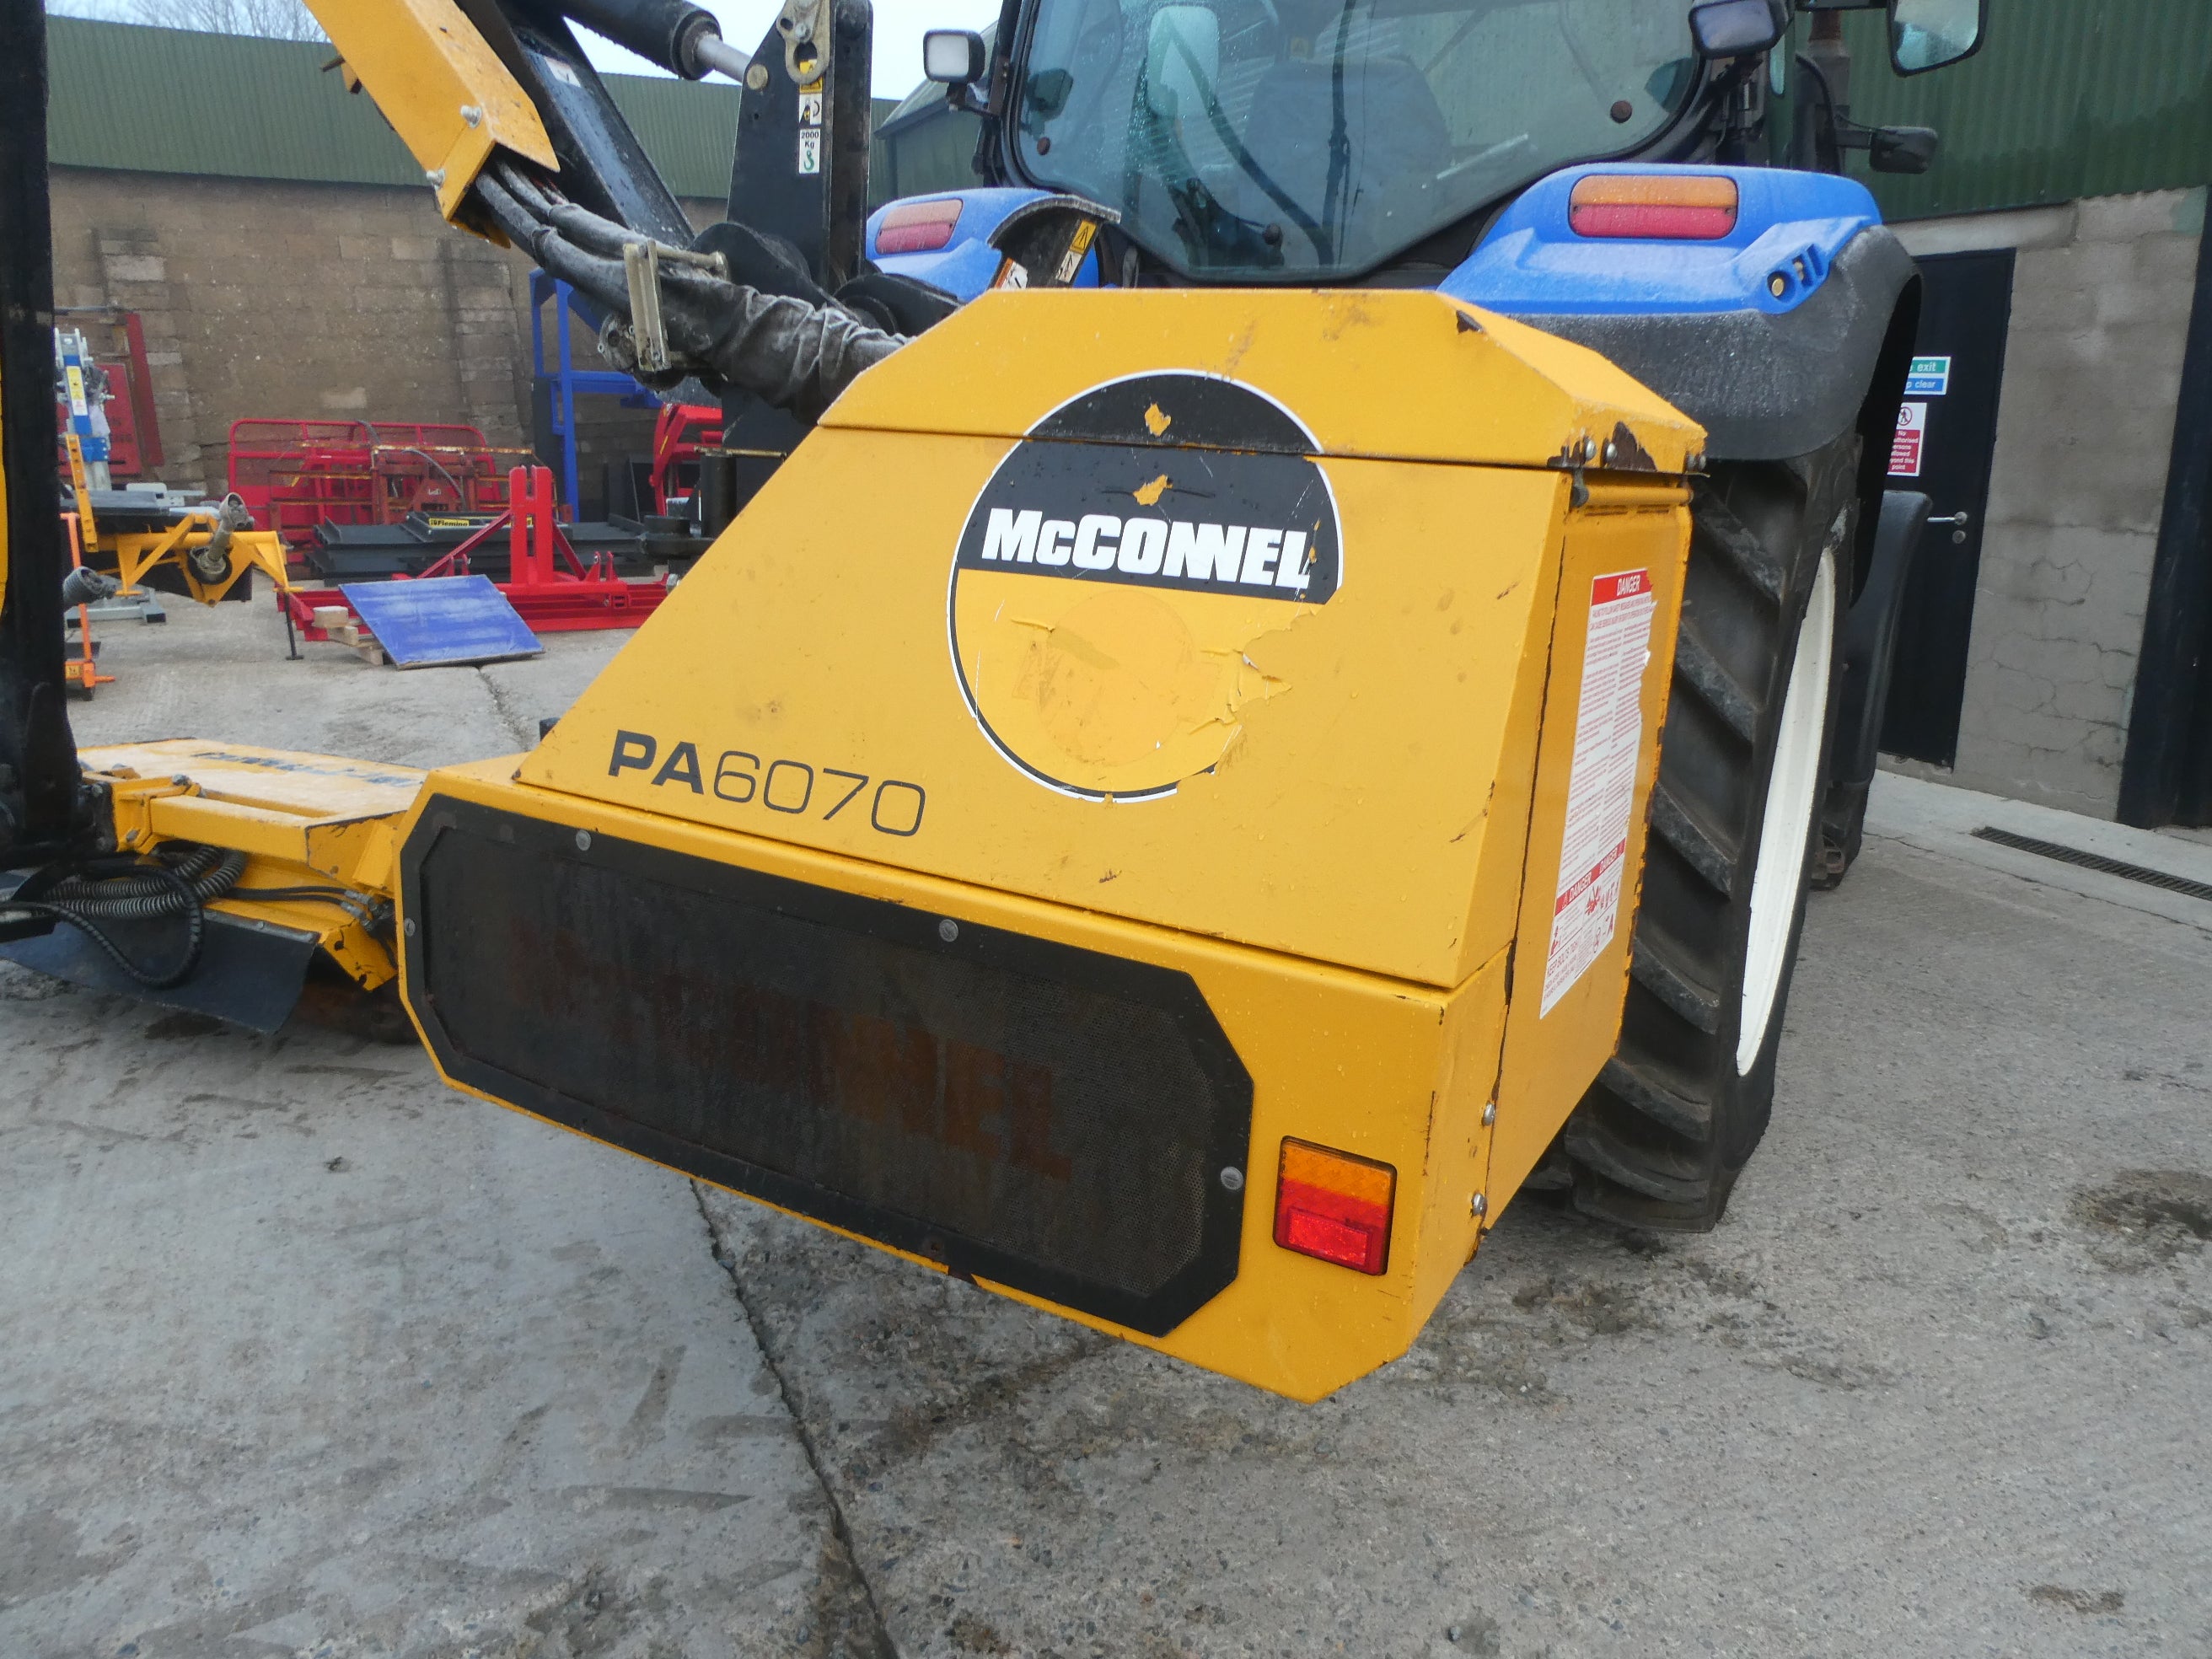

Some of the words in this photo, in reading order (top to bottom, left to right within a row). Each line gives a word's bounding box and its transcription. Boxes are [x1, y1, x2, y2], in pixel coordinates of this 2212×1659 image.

[801, 131, 819, 139] 2000
[1917, 362, 1936, 372] exit
[1915, 380, 1936, 389] clear
[1616, 574, 1640, 597] DANGER
[608, 729, 926, 836] PA6070
[1569, 871, 1592, 902] DANGER
[1599, 847, 1618, 874] DANGER
